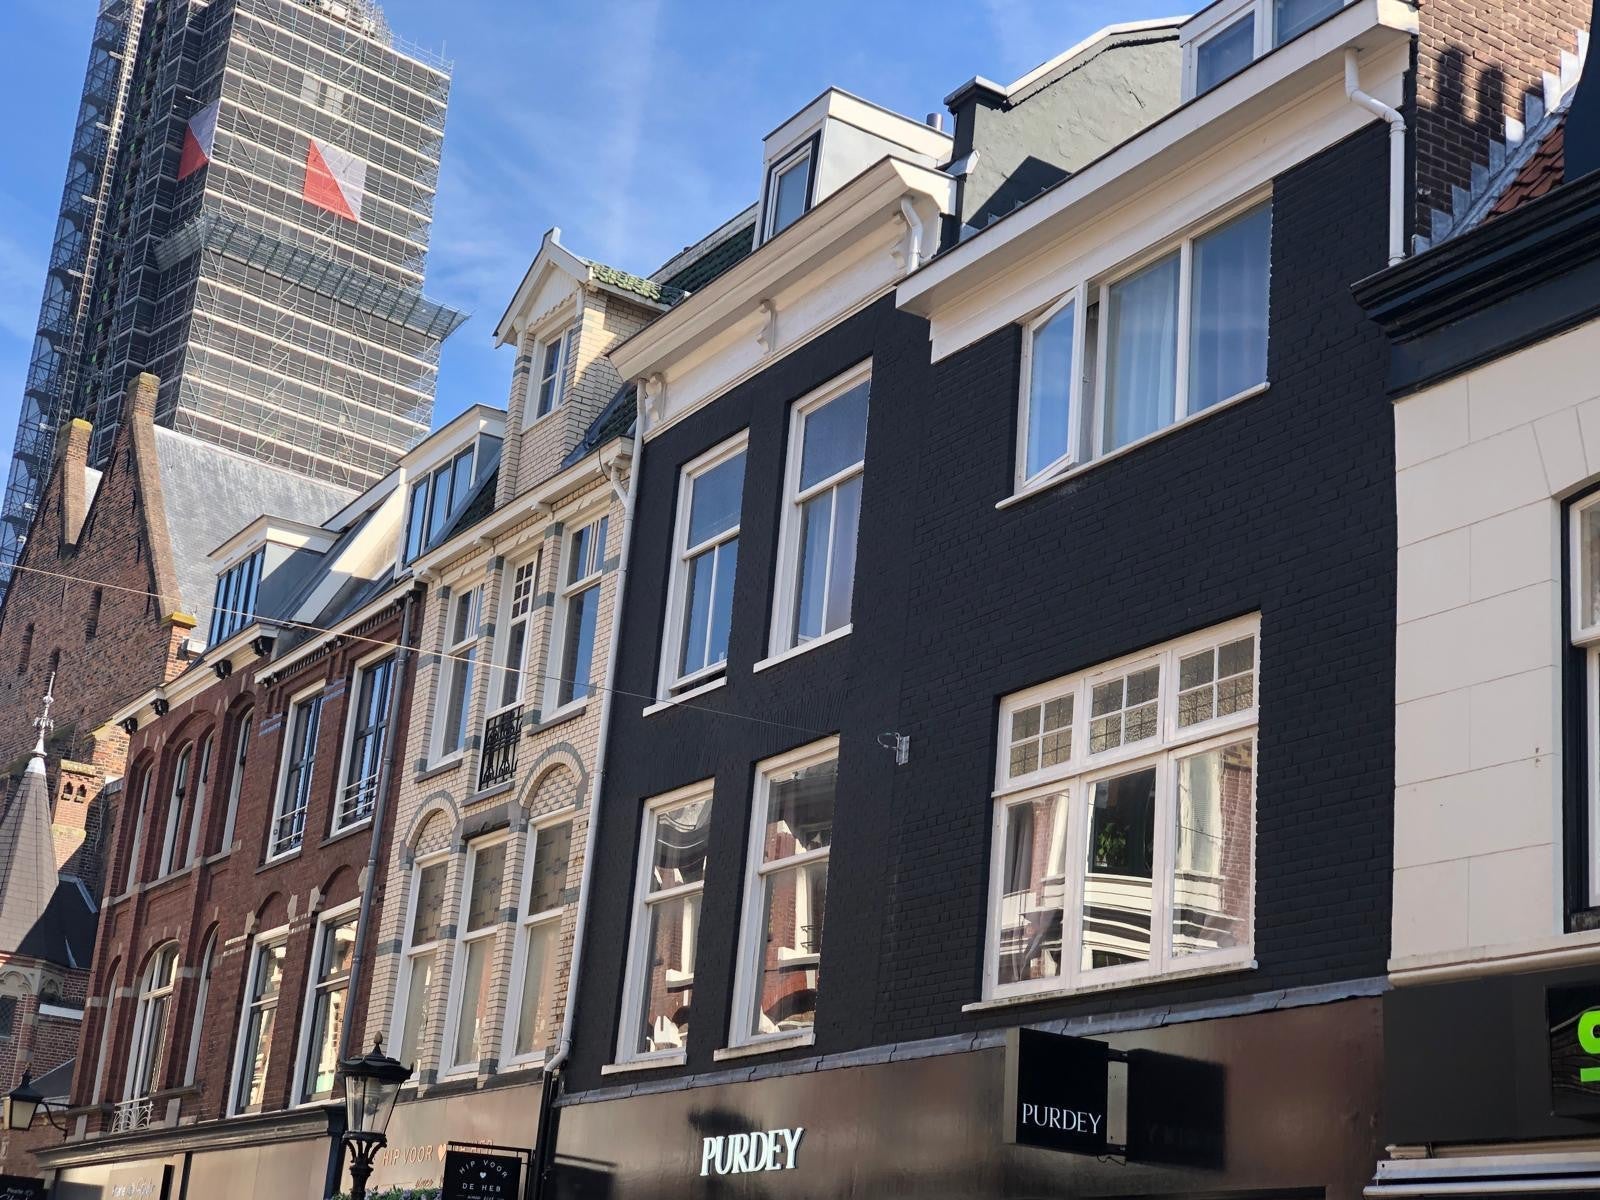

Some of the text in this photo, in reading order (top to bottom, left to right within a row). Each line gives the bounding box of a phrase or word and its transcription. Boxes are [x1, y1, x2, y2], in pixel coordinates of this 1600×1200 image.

[1022, 1103, 1102, 1134] PURDEY
[383, 1147, 400, 1166] HIP
[405, 1145, 433, 1165] VOOR
[700, 1127, 804, 1176] PURDEY
[459, 1160, 508, 1178] HIP VOOR
